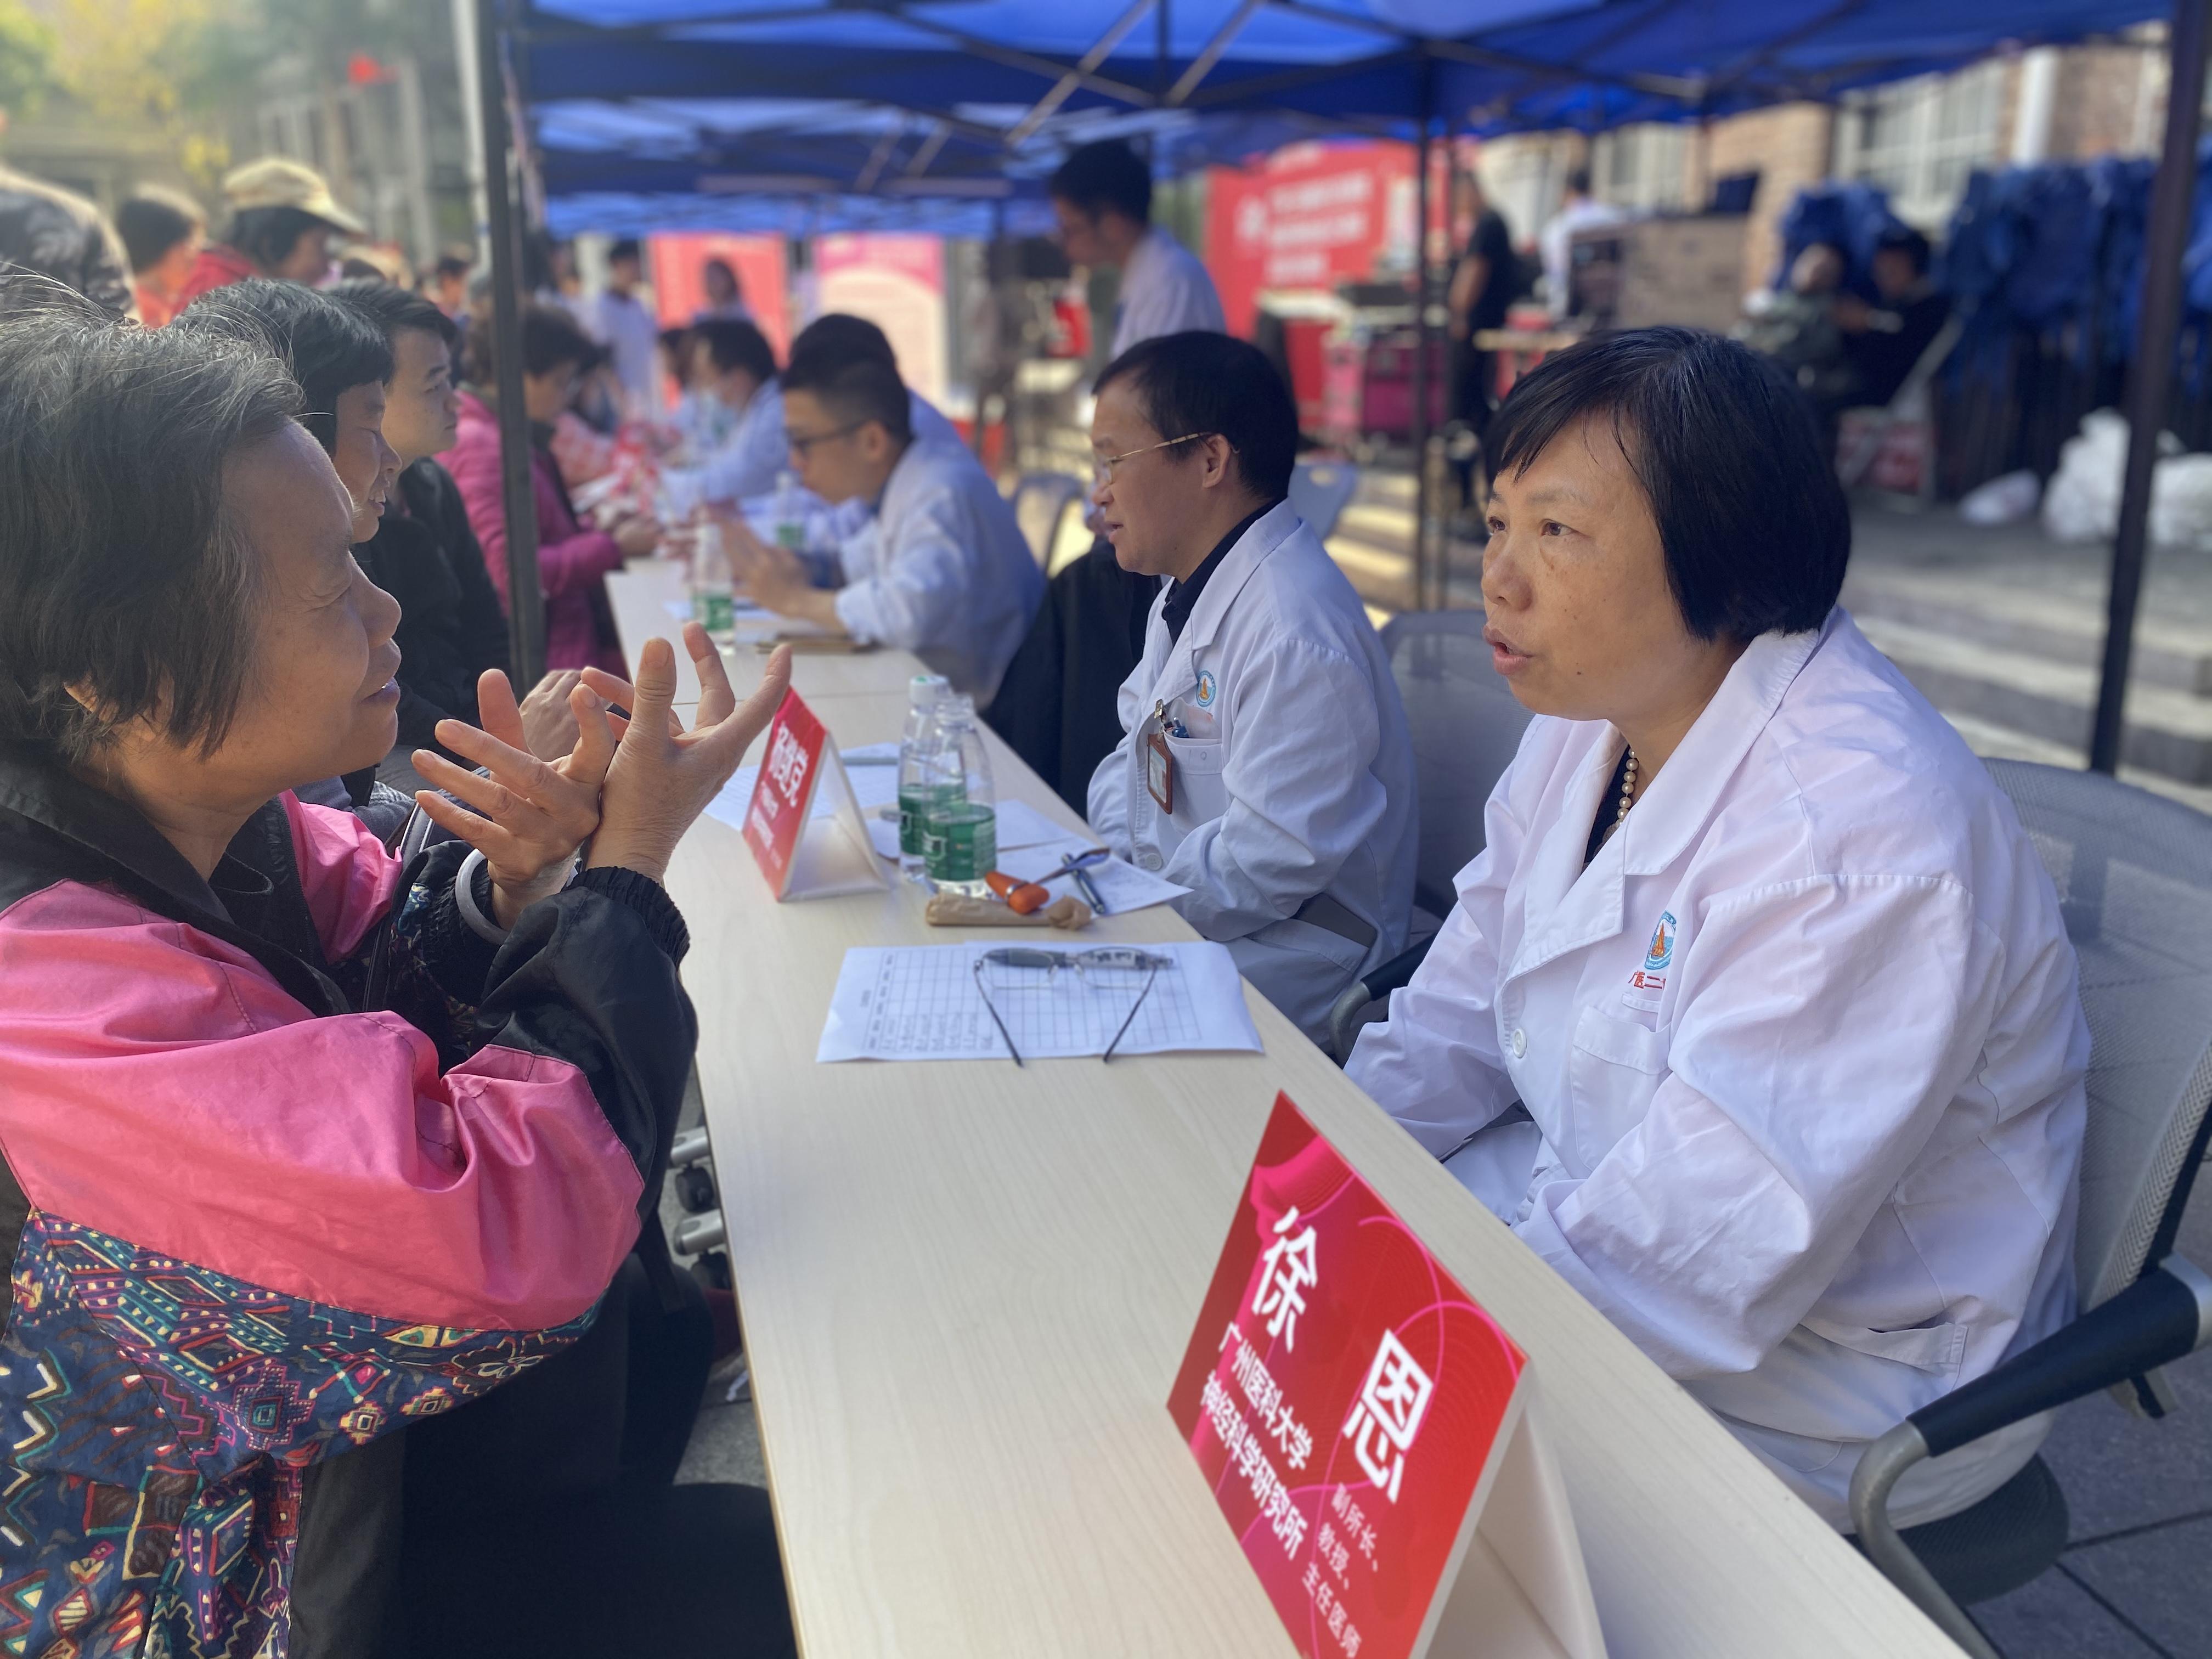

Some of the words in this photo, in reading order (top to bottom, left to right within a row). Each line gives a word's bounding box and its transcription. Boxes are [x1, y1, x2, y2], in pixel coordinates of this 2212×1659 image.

[1218, 1321, 1313, 1470] 广州医科大学
[1251, 1206, 1317, 1354] 徐
[1342, 1328, 1434, 1505] 恩
[1200, 1369, 1308, 1561] 神经科学研究所
[1301, 1561, 1362, 1659] 主任医师
